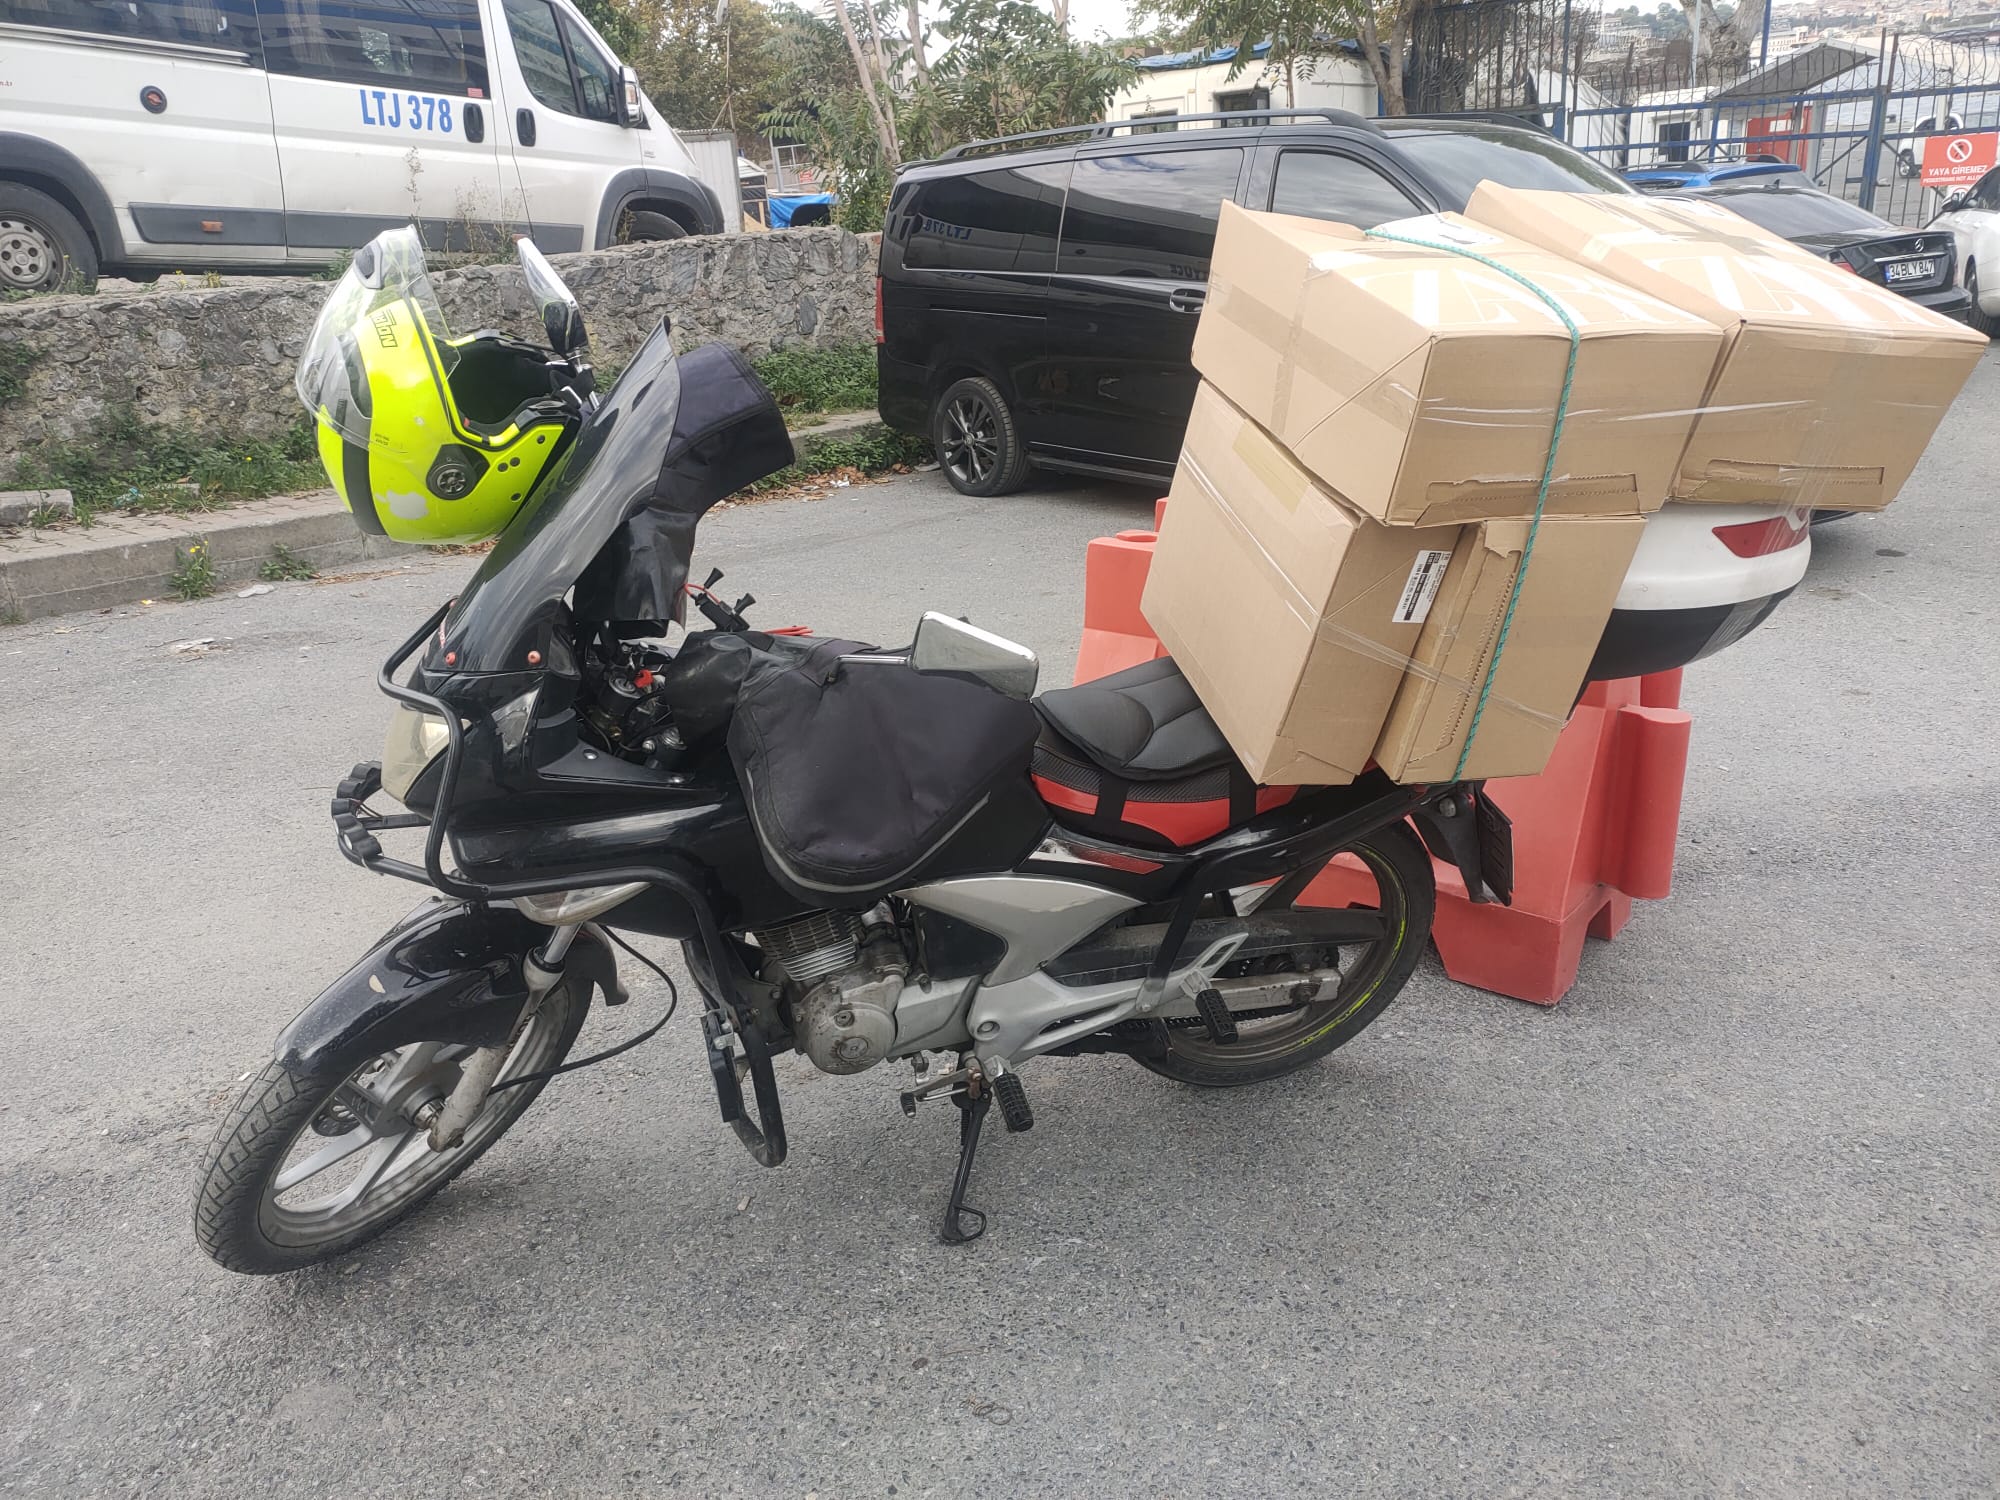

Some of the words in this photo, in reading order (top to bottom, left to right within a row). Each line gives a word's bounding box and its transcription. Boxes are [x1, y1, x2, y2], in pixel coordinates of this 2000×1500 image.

[360, 89, 400, 128] LTJ
[407, 94, 453, 133] 378
[1928, 167, 1950, 176] YAYA
[1951, 164, 1988, 175] GİREMEZ
